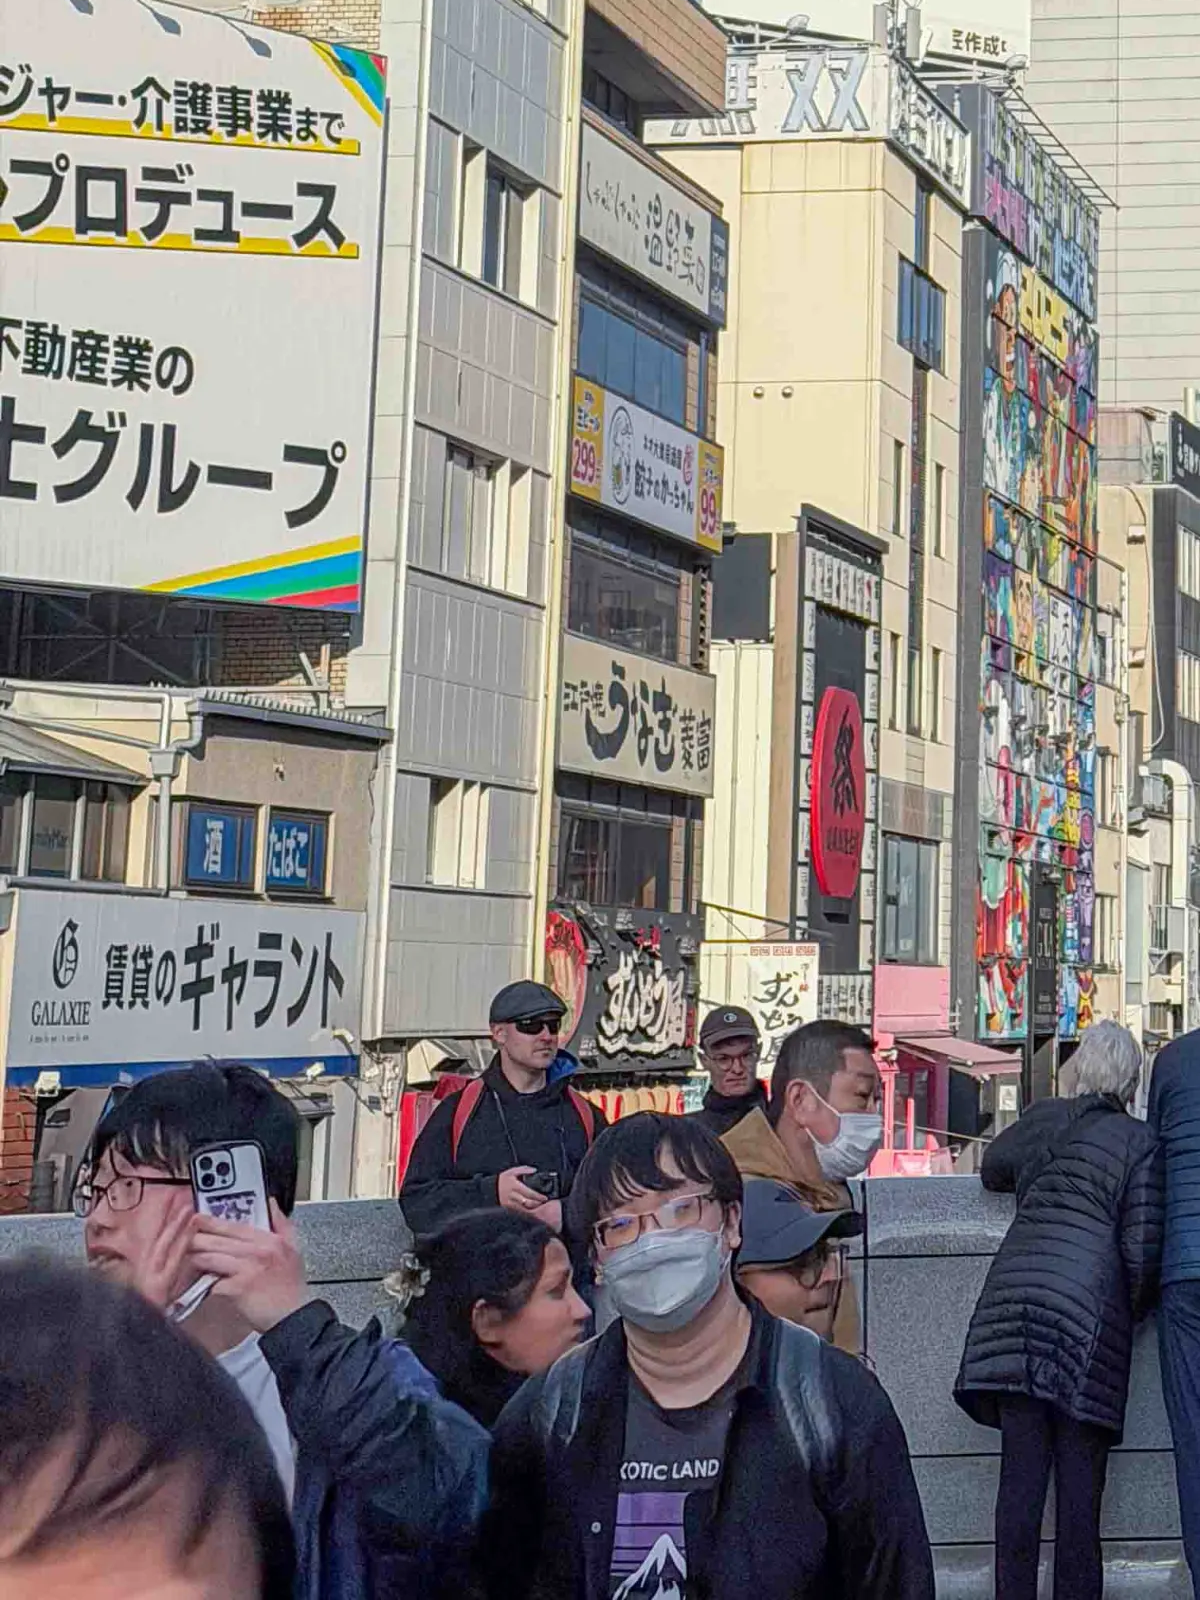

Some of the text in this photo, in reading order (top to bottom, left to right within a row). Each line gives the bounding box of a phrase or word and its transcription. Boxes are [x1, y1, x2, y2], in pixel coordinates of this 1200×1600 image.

[0, 152, 347, 252] プロデュース
[585, 661, 677, 772] うなぎ
[204, 818, 309, 878] 酒 たばこ
[31, 1000, 91, 1026] GALAXIE
[102, 921, 345, 1031] 賃貸のギャラント
[672, 1459, 720, 1479] LAND
